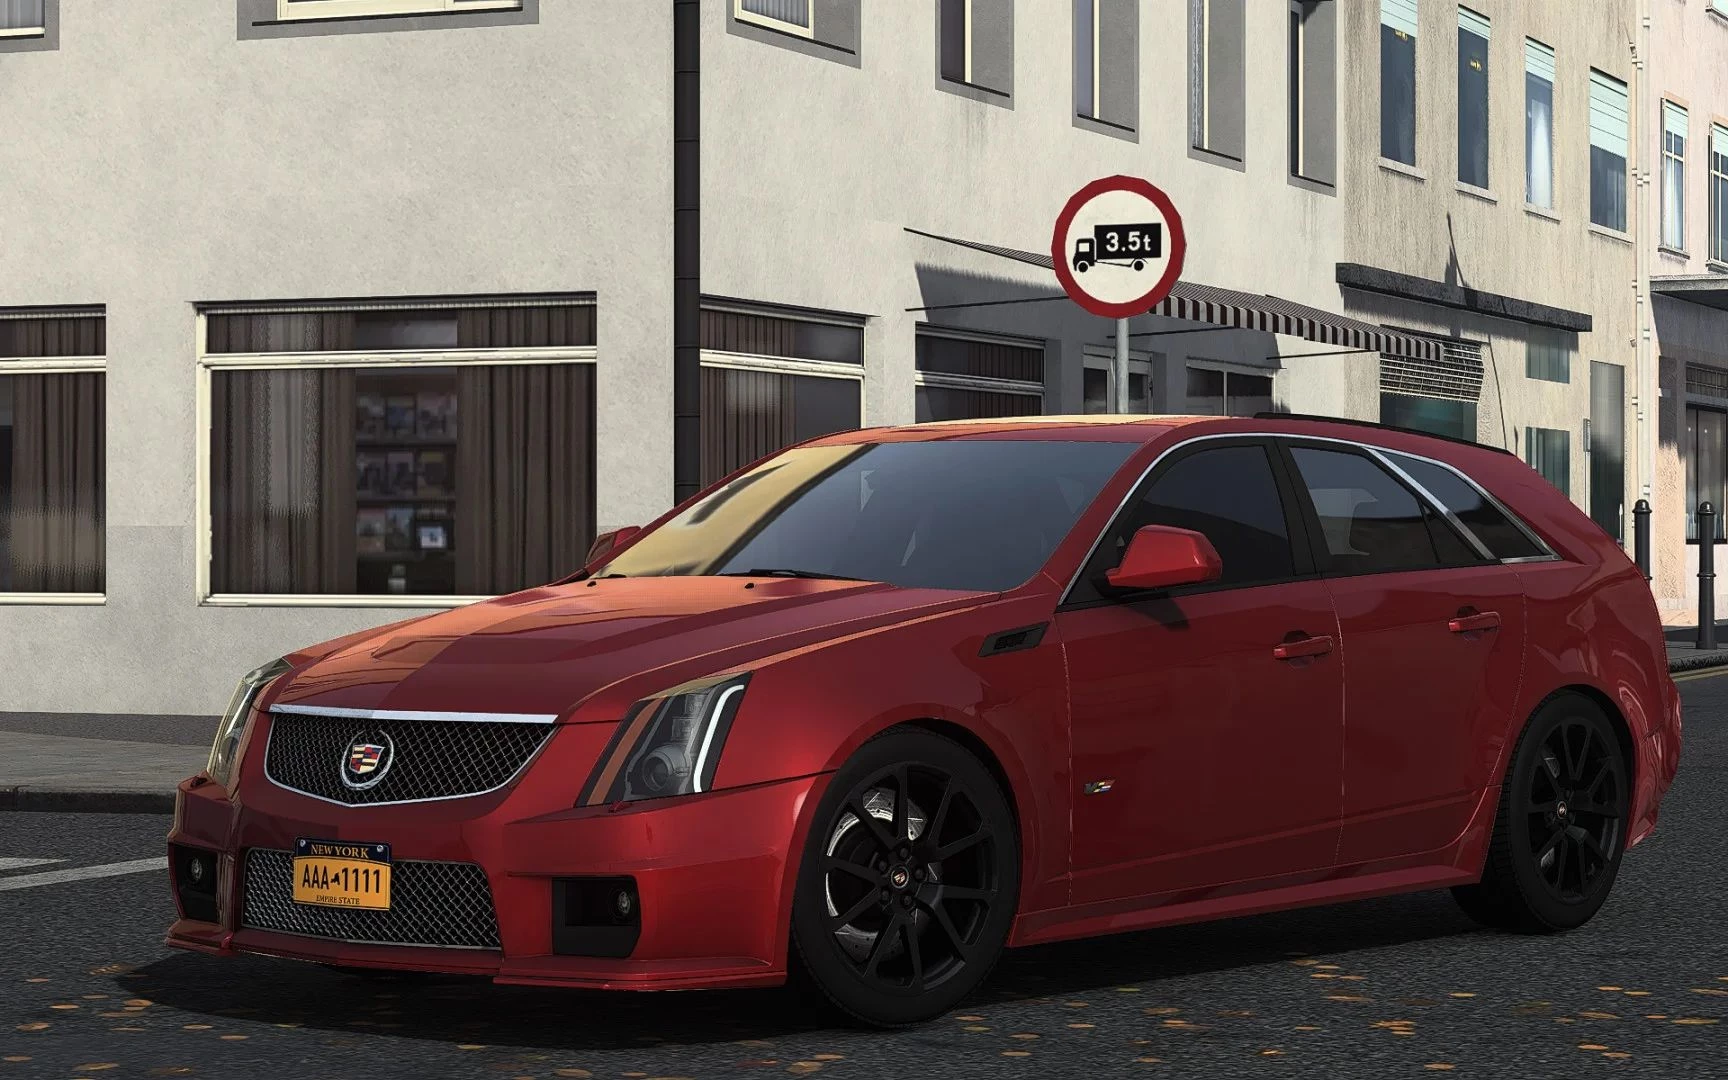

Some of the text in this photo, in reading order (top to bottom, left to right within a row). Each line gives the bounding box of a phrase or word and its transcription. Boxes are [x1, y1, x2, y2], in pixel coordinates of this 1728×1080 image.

[1105, 231, 1151, 252] 3.5t
[311, 844, 369, 859] NEW YORK
[316, 895, 360, 905] EMPIRE STATE
